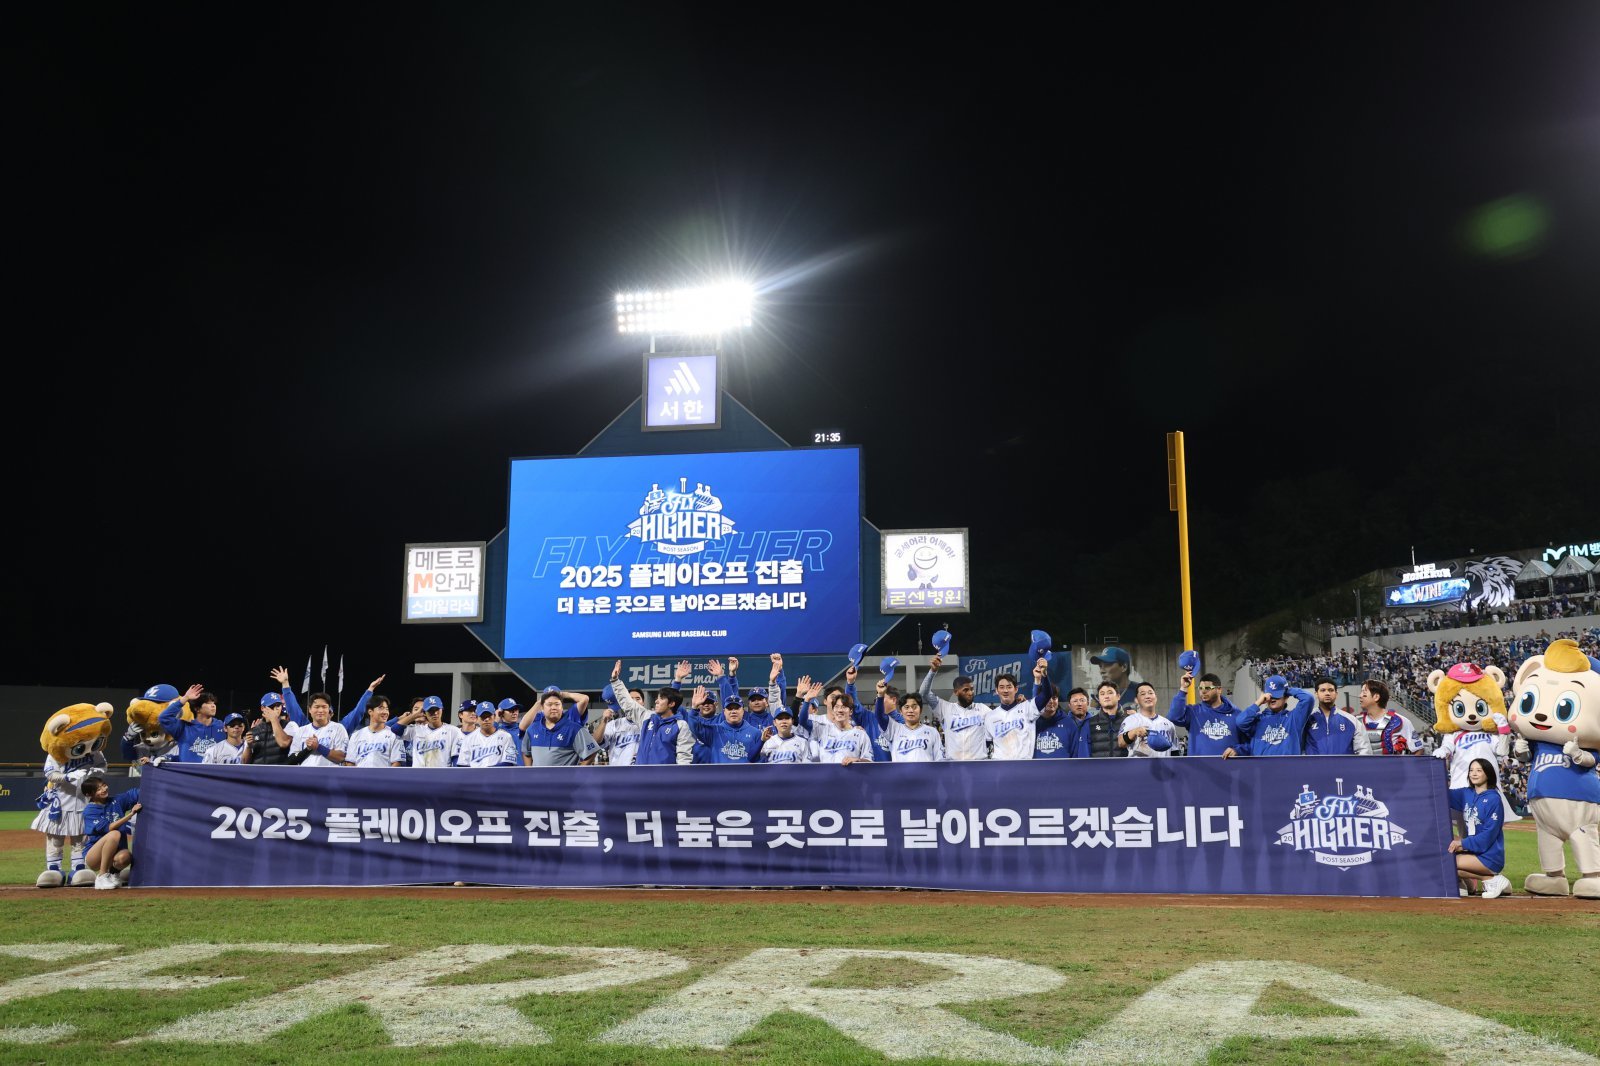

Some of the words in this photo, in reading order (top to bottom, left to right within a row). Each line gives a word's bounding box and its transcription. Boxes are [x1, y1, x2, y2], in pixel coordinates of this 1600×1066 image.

[660, 400, 704, 420] 서한
[815, 433, 841, 443] 21:35
[661, 492, 698, 515] FLY
[641, 511, 721, 543] HIGHER
[415, 550, 475, 571] 메트로
[559, 565, 623, 588] 2025
[629, 562, 748, 588] 플레이오프
[755, 560, 804, 585] 진출
[557, 597, 574, 614] 더
[578, 596, 612, 614] 높은
[615, 595, 666, 613] 곳으로
[670, 591, 807, 612] 날아오르겠습니다
[632, 630, 661, 639] SAMSUNG
[663, 630, 680, 639] LIONS
[681, 630, 711, 638] BASEBALL
[712, 629, 727, 637] CLUB
[965, 659, 988, 673] FLY
[994, 718, 1025, 738] Lions
[357, 741, 389, 757] Lions
[416, 739, 446, 755] Lions
[824, 739, 857, 754] Lions
[897, 738, 929, 755] Lions
[1458, 733, 1492, 749] Lions
[471, 744, 503, 762] Lions
[1534, 752, 1572, 773] Lions
[1314, 795, 1358, 820] FLY
[211, 806, 312, 841] 2025
[325, 807, 513, 844] 플레이오프
[523, 809, 614, 853] 진출,
[625, 810, 663, 848] 더
[676, 810, 754, 848] 높은
[766, 809, 888, 848] 곳으로
[900, 806, 1244, 849] 날아오르겠습니다
[1293, 816, 1392, 853] HIGHER
[1322, 856, 1340, 864] POST
[1341, 856, 1365, 864] SEASON
